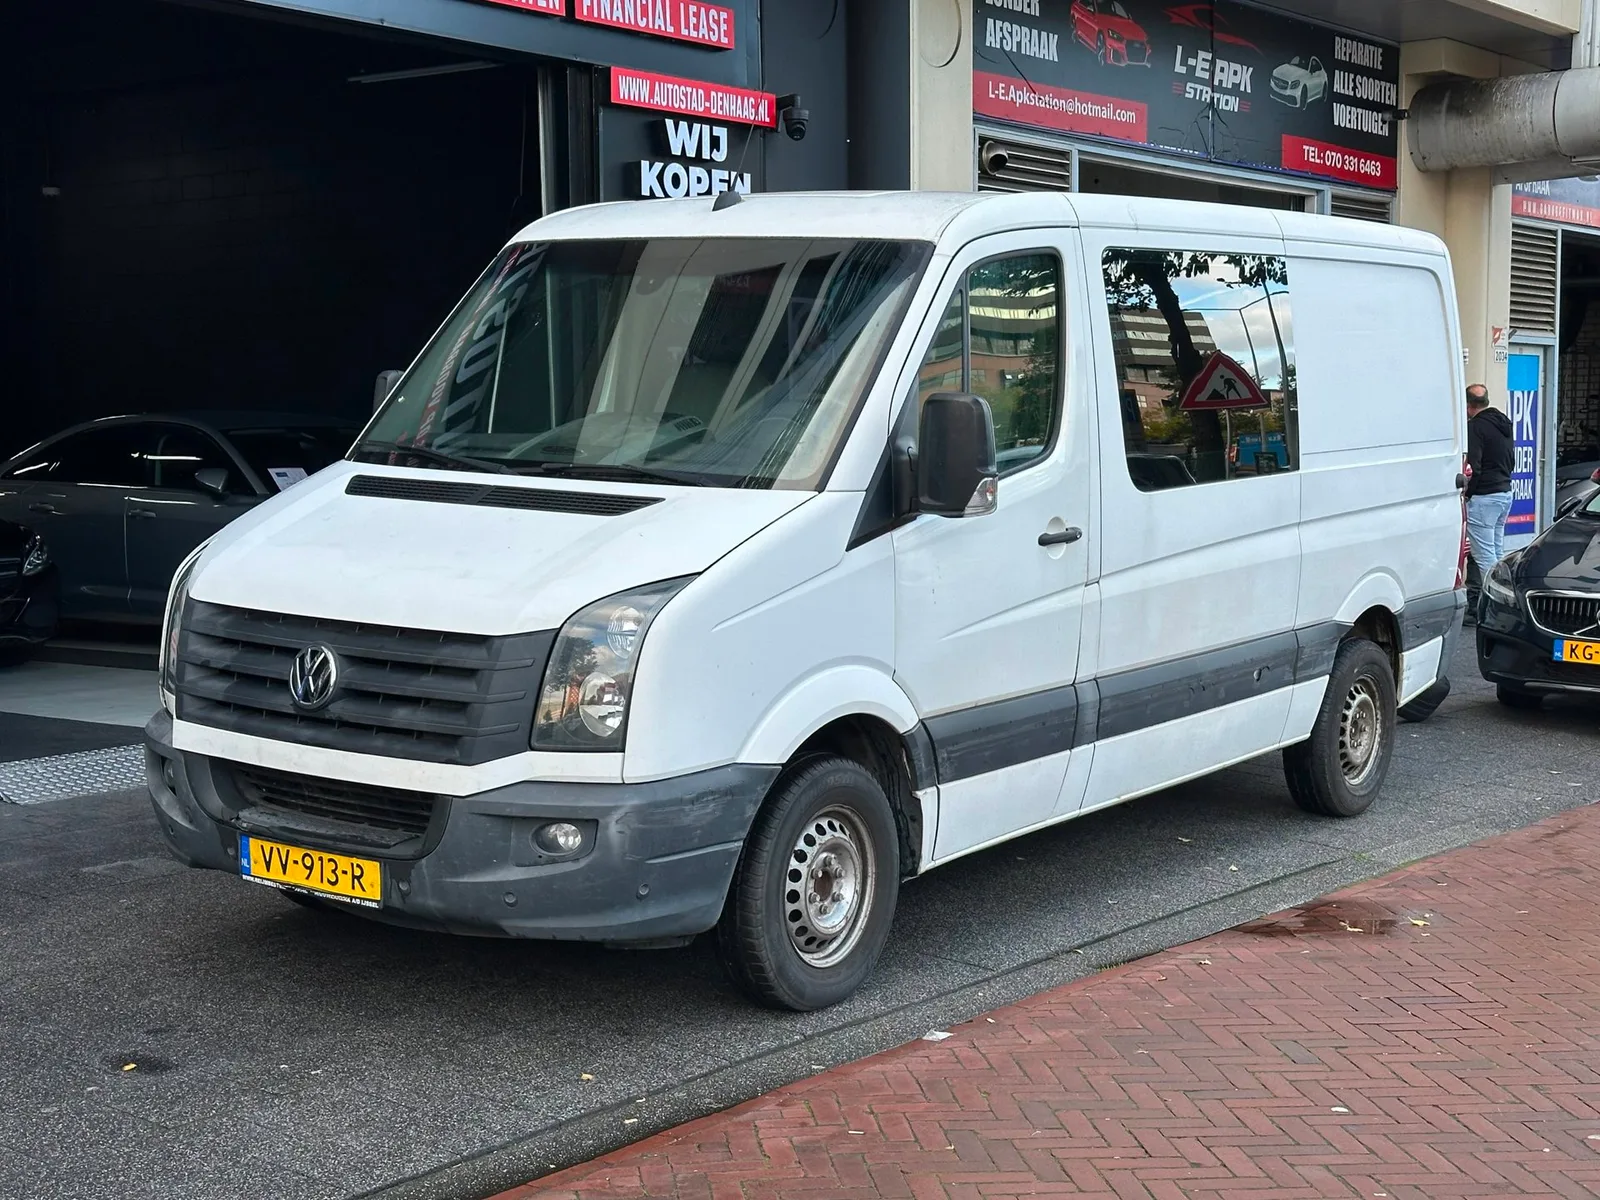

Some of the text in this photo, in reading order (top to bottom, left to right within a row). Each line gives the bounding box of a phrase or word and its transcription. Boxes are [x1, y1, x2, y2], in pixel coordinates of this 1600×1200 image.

[680, 2, 729, 44] LEASE
[985, 17, 1059, 63] AFSPRAAK
[1174, 44, 1254, 94] L-E APK
[1334, 36, 1383, 71] REPARATIE
[618, 75, 770, 123] WWW.AUTOSTAD-DENHAAG.NL
[988, 80, 1136, 124] L-E.Apkstation@hotmail.com
[1184, 81, 1239, 112] STATION
[1333, 69, 1397, 107] ALLE SOORTEN
[665, 118, 728, 162] WIJ
[1303, 144, 1381, 177] TEL: 070 331 6463
[241, 857, 250, 868] NL
[260, 844, 367, 893] VV-913-R
